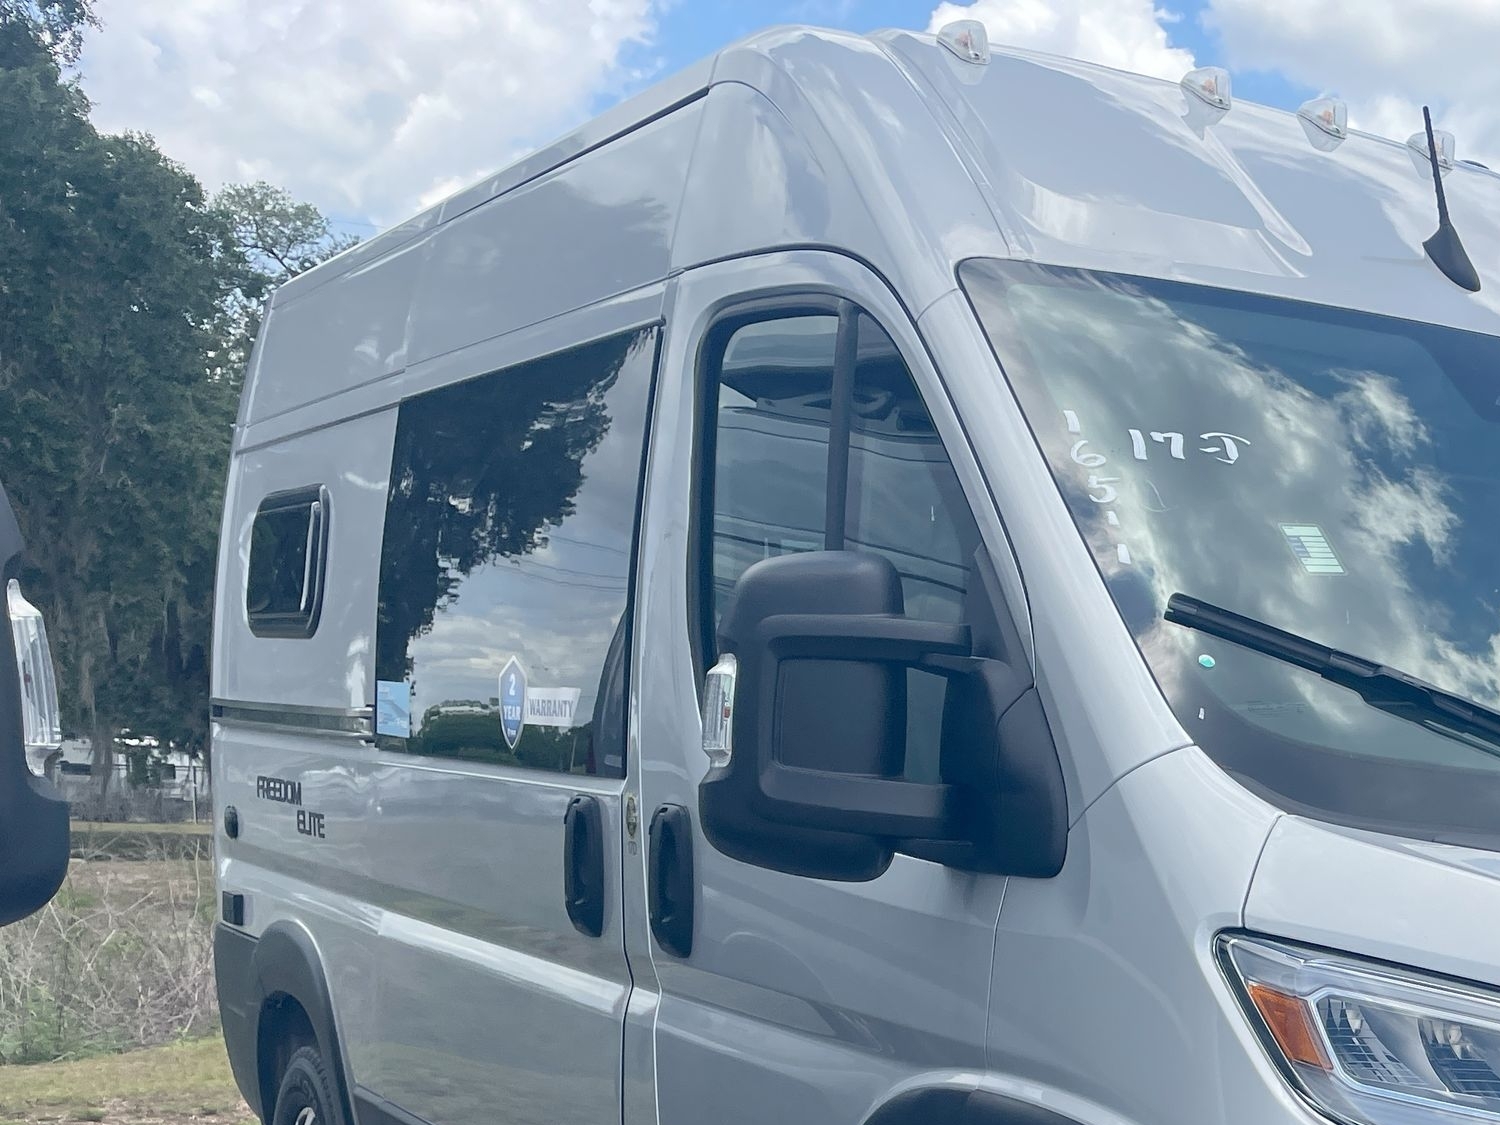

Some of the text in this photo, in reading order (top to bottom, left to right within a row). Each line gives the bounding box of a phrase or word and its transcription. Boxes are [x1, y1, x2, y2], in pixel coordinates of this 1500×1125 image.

[509, 673, 516, 696] 2
[503, 705, 521, 720] YEAR
[529, 698, 574, 718] WARRANTY
[256, 775, 302, 806] FREEDOM
[297, 810, 326, 839] ELITE
